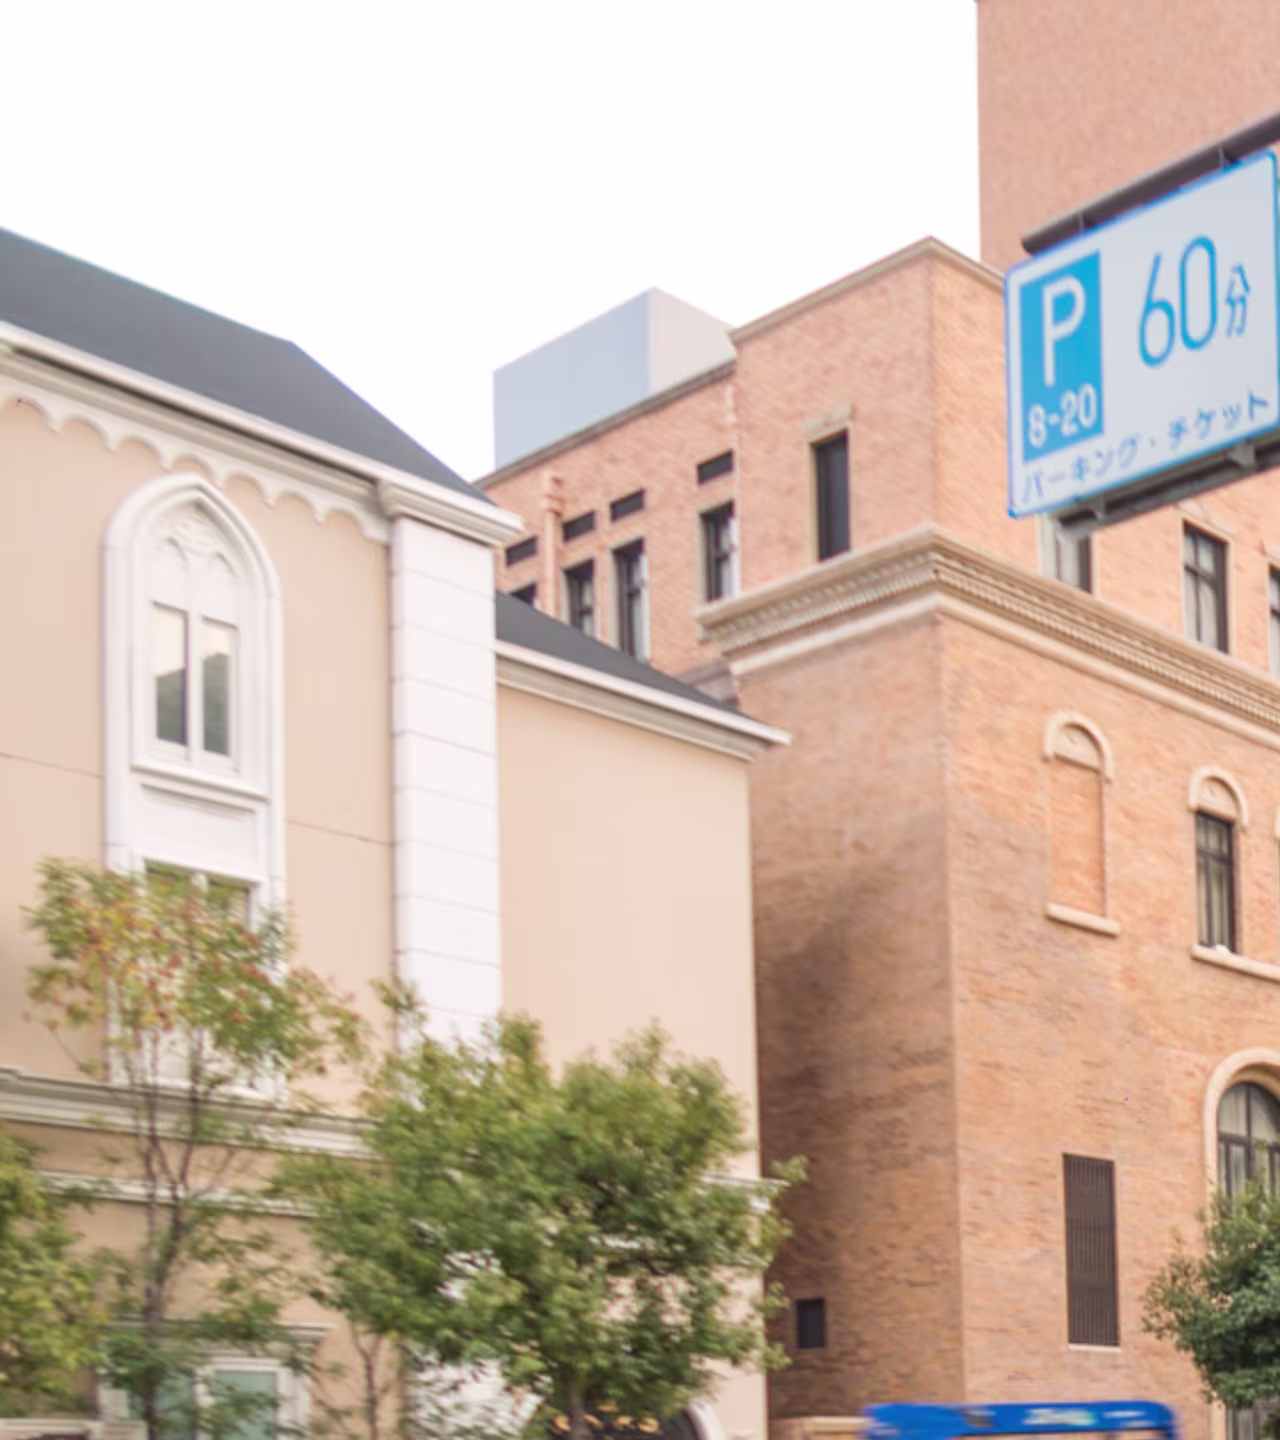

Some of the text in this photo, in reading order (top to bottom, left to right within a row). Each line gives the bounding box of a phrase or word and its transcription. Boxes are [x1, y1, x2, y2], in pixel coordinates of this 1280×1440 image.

[1041, 275, 1087, 387] P
[1138, 235, 1251, 369] 60分
[1027, 382, 1098, 449] 8-20
